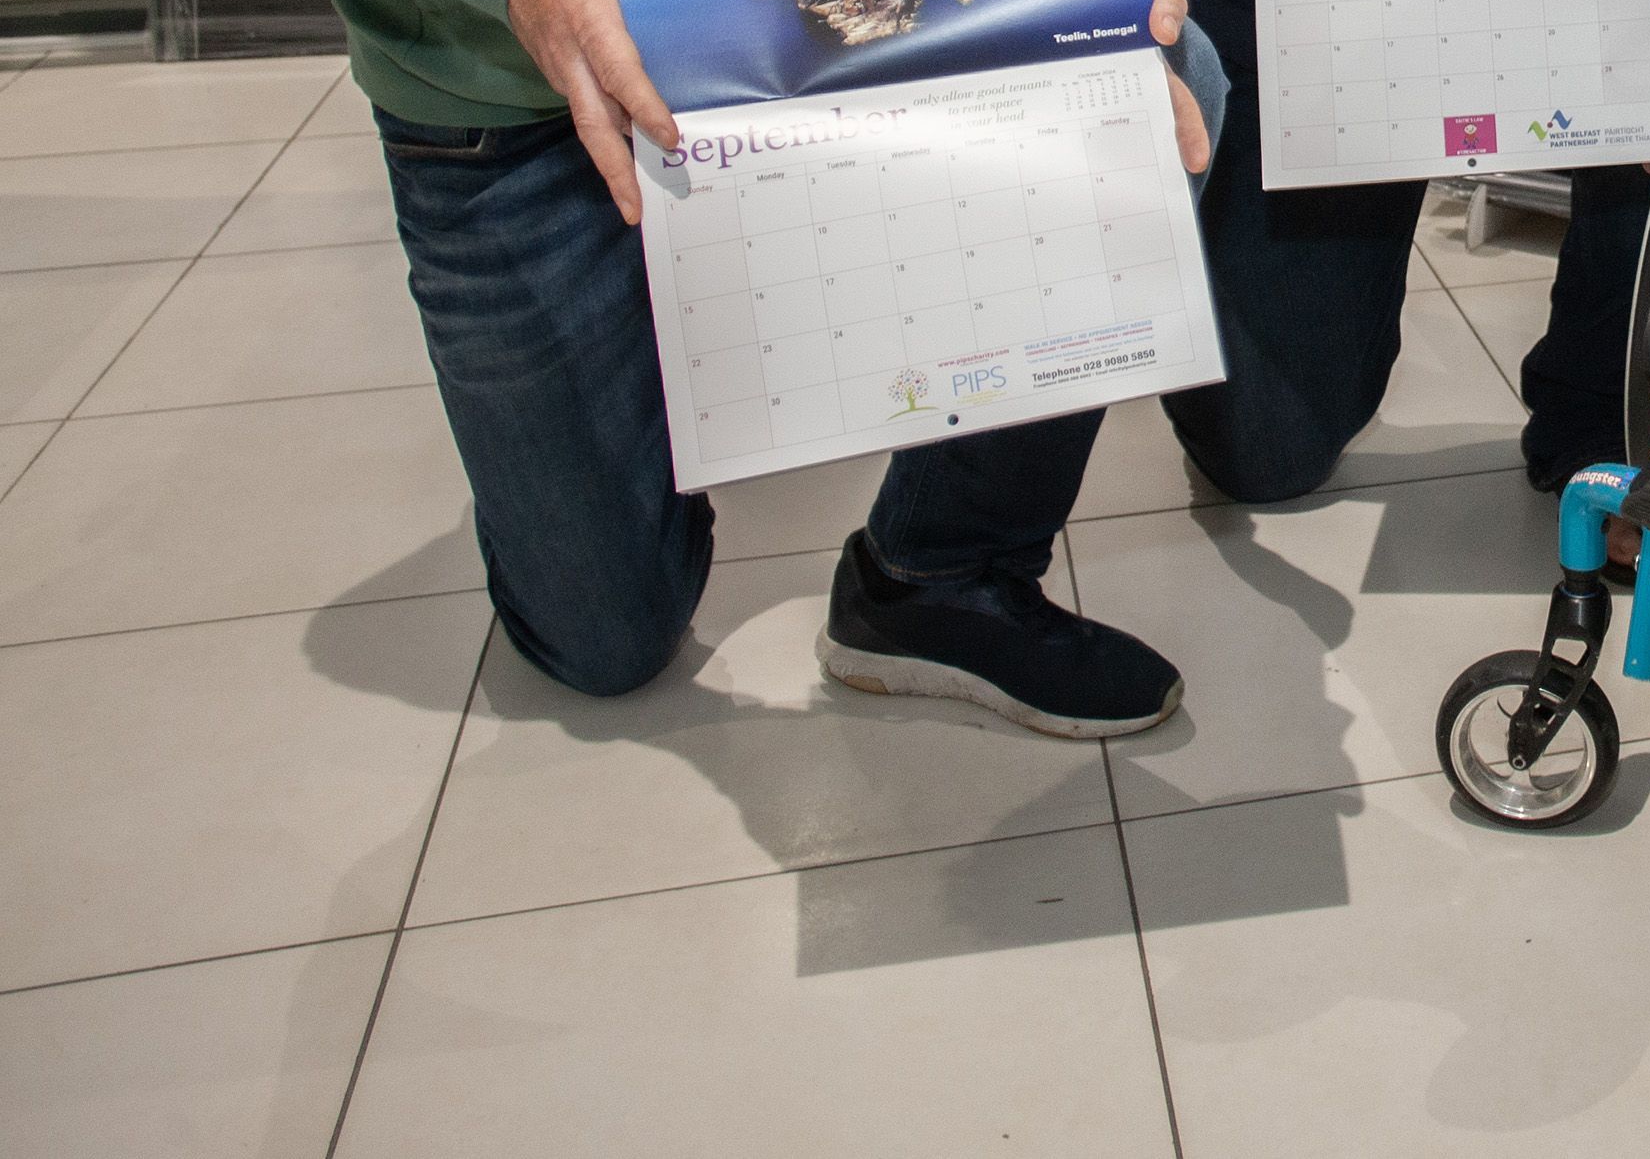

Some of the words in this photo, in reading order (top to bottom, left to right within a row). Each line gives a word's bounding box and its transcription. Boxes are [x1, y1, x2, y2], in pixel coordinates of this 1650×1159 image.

[1053, 31, 1091, 43] Teelin,
[1092, 24, 1137, 38] Donegal
[913, 94, 940, 108] only
[942, 89, 974, 103] allow
[977, 84, 1006, 99] good
[1009, 79, 1053, 93] tenants
[962, 102, 988, 114] rent
[990, 97, 1023, 112] space
[996, 111, 1025, 123] head
[1100, 117, 1130, 127] Saturday
[662, 106, 907, 169] September
[1549, 131, 1568, 140] WEST
[1570, 129, 1601, 138] BELFAST
[1550, 138, 1598, 148] PARTNERSHIP
[890, 147, 931, 159] Wednesday
[827, 159, 857, 170] Tuesday
[756, 172, 785, 182] Monday
[687, 185, 713, 195] Sunday
[818, 226, 827, 235] 10
[825, 278, 834, 287] 17
[1112, 274, 1122, 282] 28
[684, 306, 693, 314] 15
[974, 302, 983, 310] 26
[834, 330, 843, 339] 24
[763, 344, 772, 353] 23
[938, 349, 1010, 368] www.pipscharity.com
[1032, 365, 1081, 382] Telephone
[1083, 360, 1102, 372] 028
[1105, 354, 1129, 366] 9080
[1131, 348, 1155, 361] 5850
[952, 365, 1007, 397] PIPS
[771, 397, 781, 406] 30
